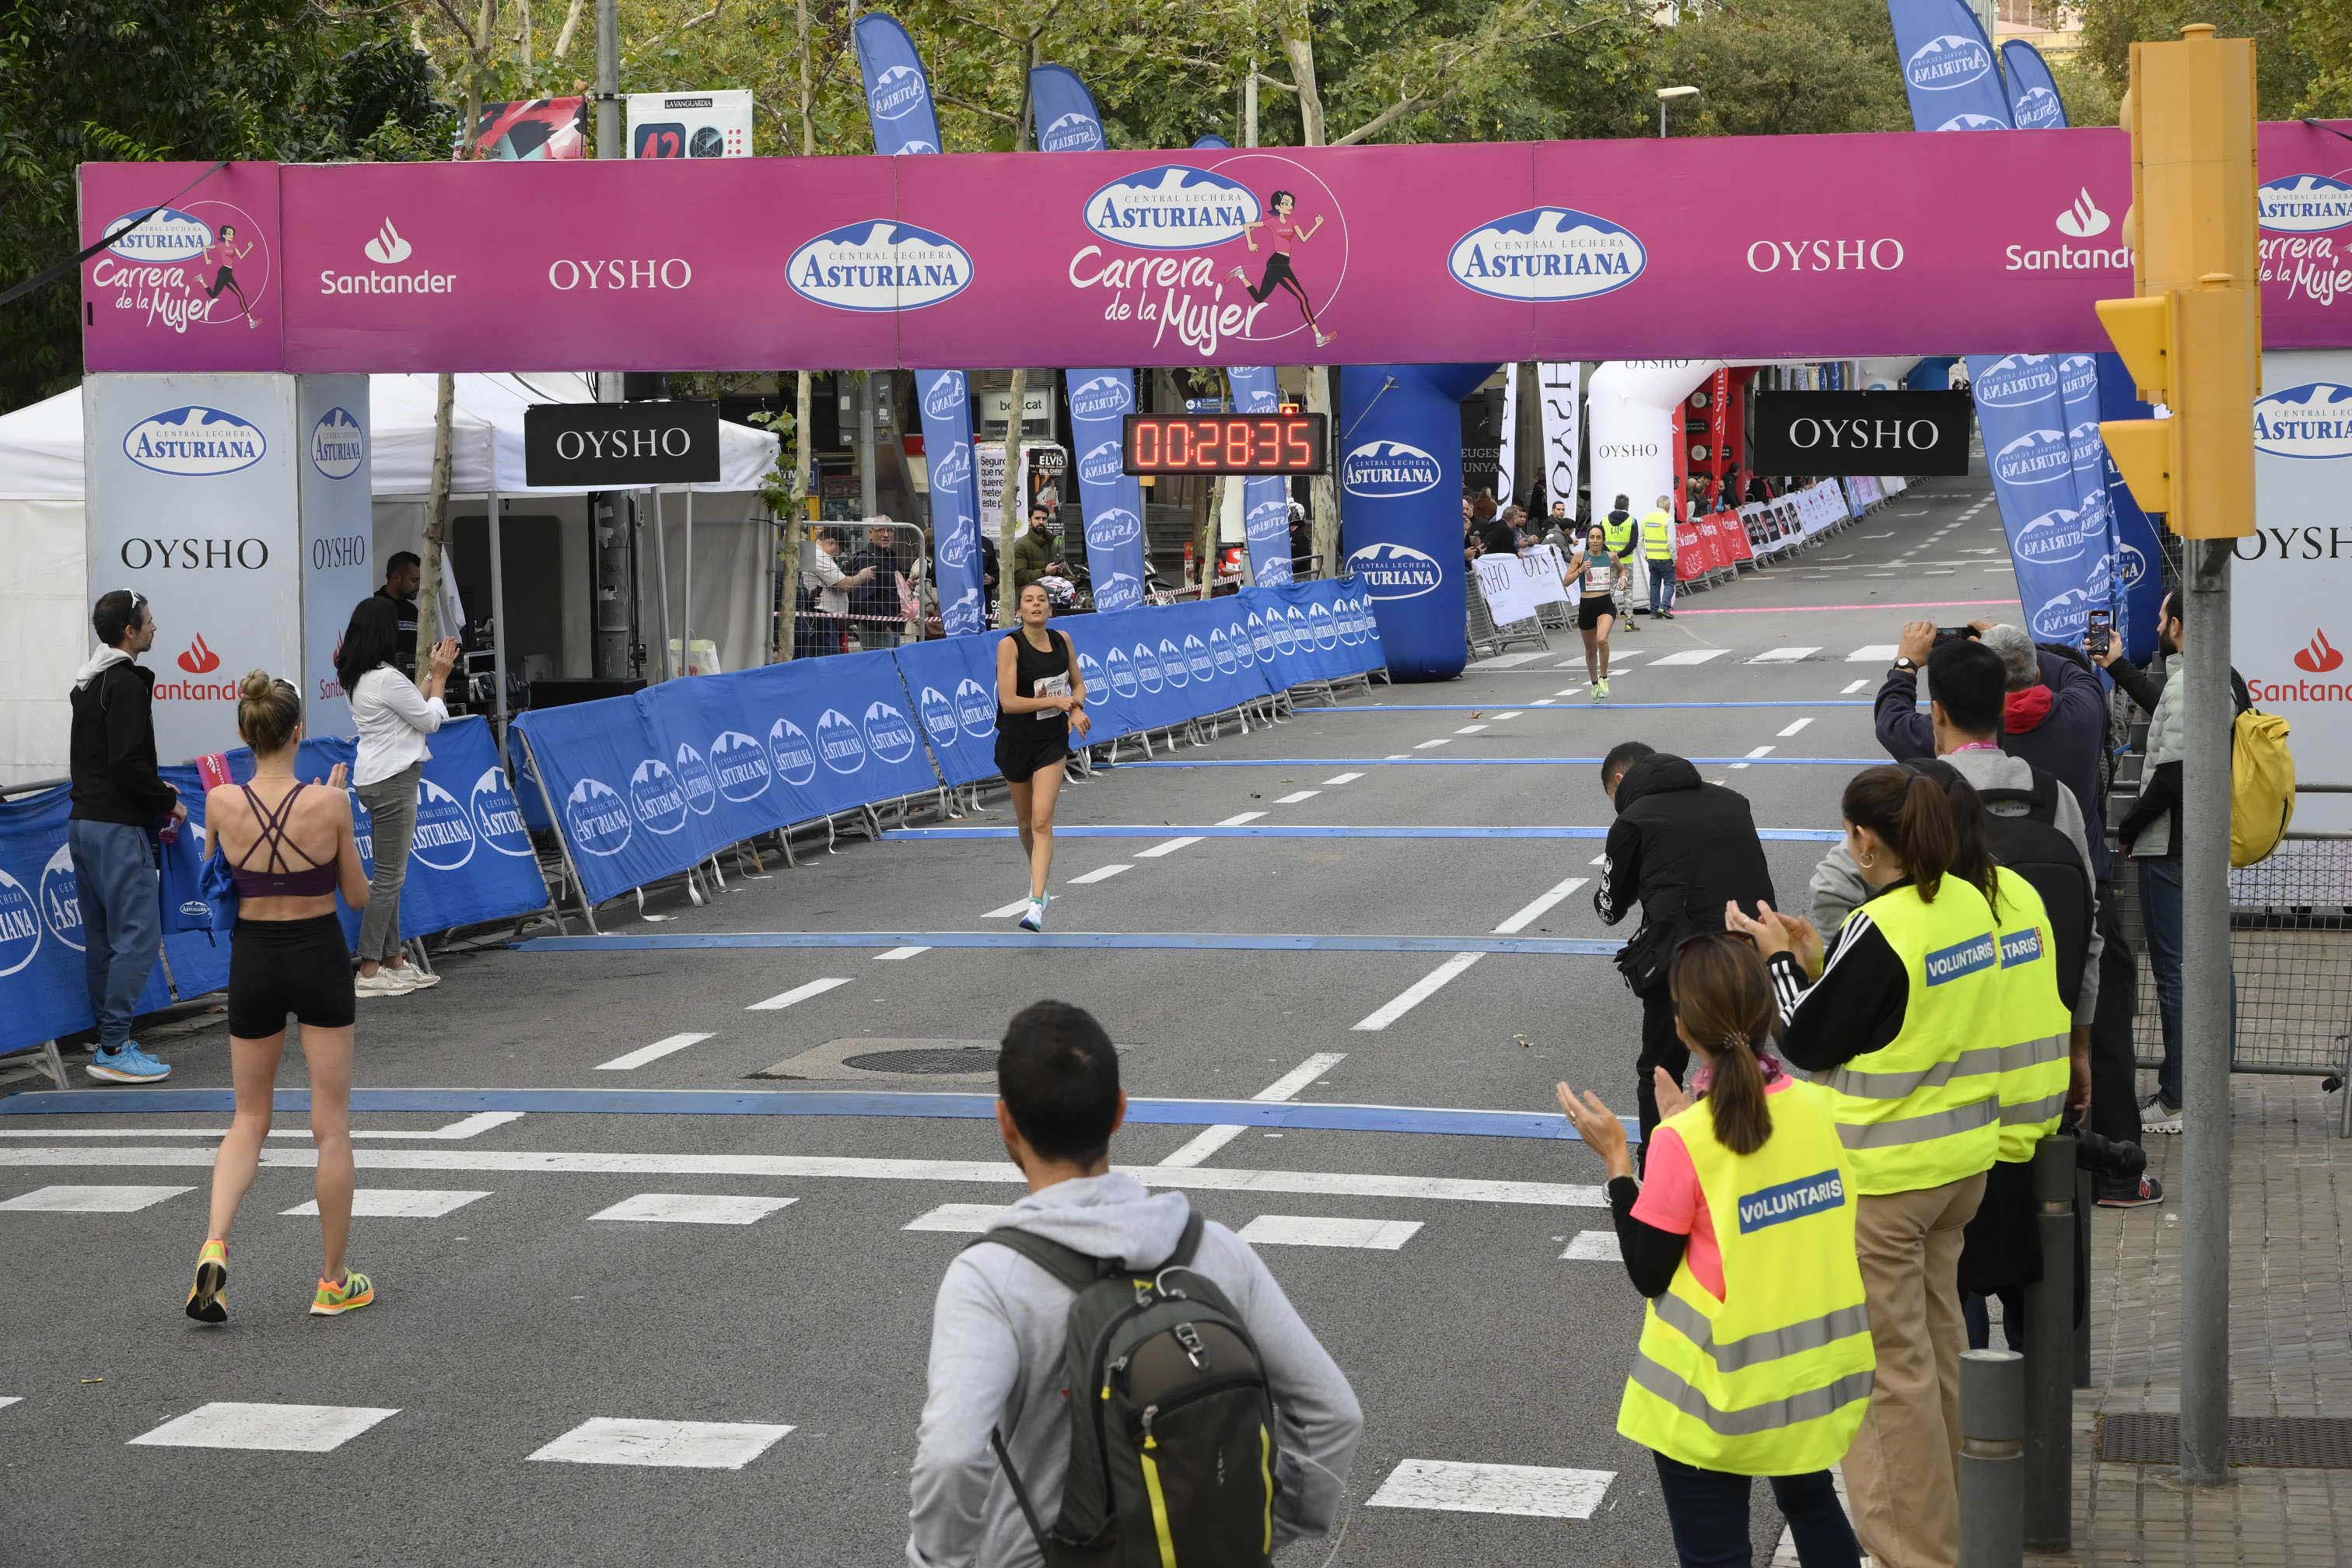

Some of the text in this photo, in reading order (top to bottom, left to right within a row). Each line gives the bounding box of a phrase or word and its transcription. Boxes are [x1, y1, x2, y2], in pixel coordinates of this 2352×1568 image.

[1125, 193, 1242, 203] CENTRAL LECHERA
[1097, 198, 1244, 229] ASTURIANA
[829, 250, 953, 261] CENTRAL LECHERA
[1494, 239, 1624, 250] CENTRAL LECHERA
[1747, 238, 1905, 273] OYSHO
[2005, 243, 2134, 271] Santand
[2259, 236, 2333, 259] arrera
[93, 259, 184, 287] Carrera
[548, 258, 691, 290] OYSHO
[801, 254, 959, 288] ASTURIANA
[1069, 245, 1214, 289] Carrera
[1463, 243, 1631, 278] ASTURIANA
[320, 270, 457, 294] Santander
[2277, 260, 2291, 281] la
[2287, 255, 2352, 306] Muje
[116, 285, 219, 333] de la Mujer
[1105, 283, 1269, 356] de la Mujer
[2254, 412, 2352, 439] ASTURI
[2274, 409, 2327, 418] CENTRAL
[134, 432, 256, 459] ASTURIANA
[156, 429, 252, 438] CENTRAL LECHERA
[315, 433, 361, 461] ASTURIANA
[556, 427, 691, 460] OYSHO
[1137, 422, 1310, 465] 00:28:35
[1789, 417, 1938, 450] OYSHO
[1039, 456, 1063, 466] ELVIS
[1461, 448, 1499, 458] EUGES
[1599, 443, 1657, 459] OYSHO
[981, 469, 994, 478] que
[1346, 466, 1433, 486] ASTURIANA
[1464, 463, 1499, 473] UNYA
[982, 499, 996, 508] este
[1611, 526, 1624, 534] Life
[121, 537, 269, 570] OYSHO
[313, 535, 365, 569] OYSHO
[2232, 527, 2352, 561] OYSH
[1349, 569, 1434, 586] TURIANA
[1479, 562, 1510, 596] SHO
[152, 679, 243, 701] antand
[320, 678, 345, 700] Santa
[2248, 679, 2352, 702] Santan
[773, 746, 814, 771] ASTURIANA
[821, 735, 863, 760] ASTURIANA
[714, 758, 769, 789] ASTURIANA
[417, 809, 434, 819] ENTRAL
[485, 796, 506, 809] CENTRAL
[479, 804, 525, 837] ASTUR
[1929, 941, 1993, 977] VOLUNTARIS
[2001, 936, 2038, 961] TARIS
[1740, 1179, 1843, 1223] VOLUNTARIS
